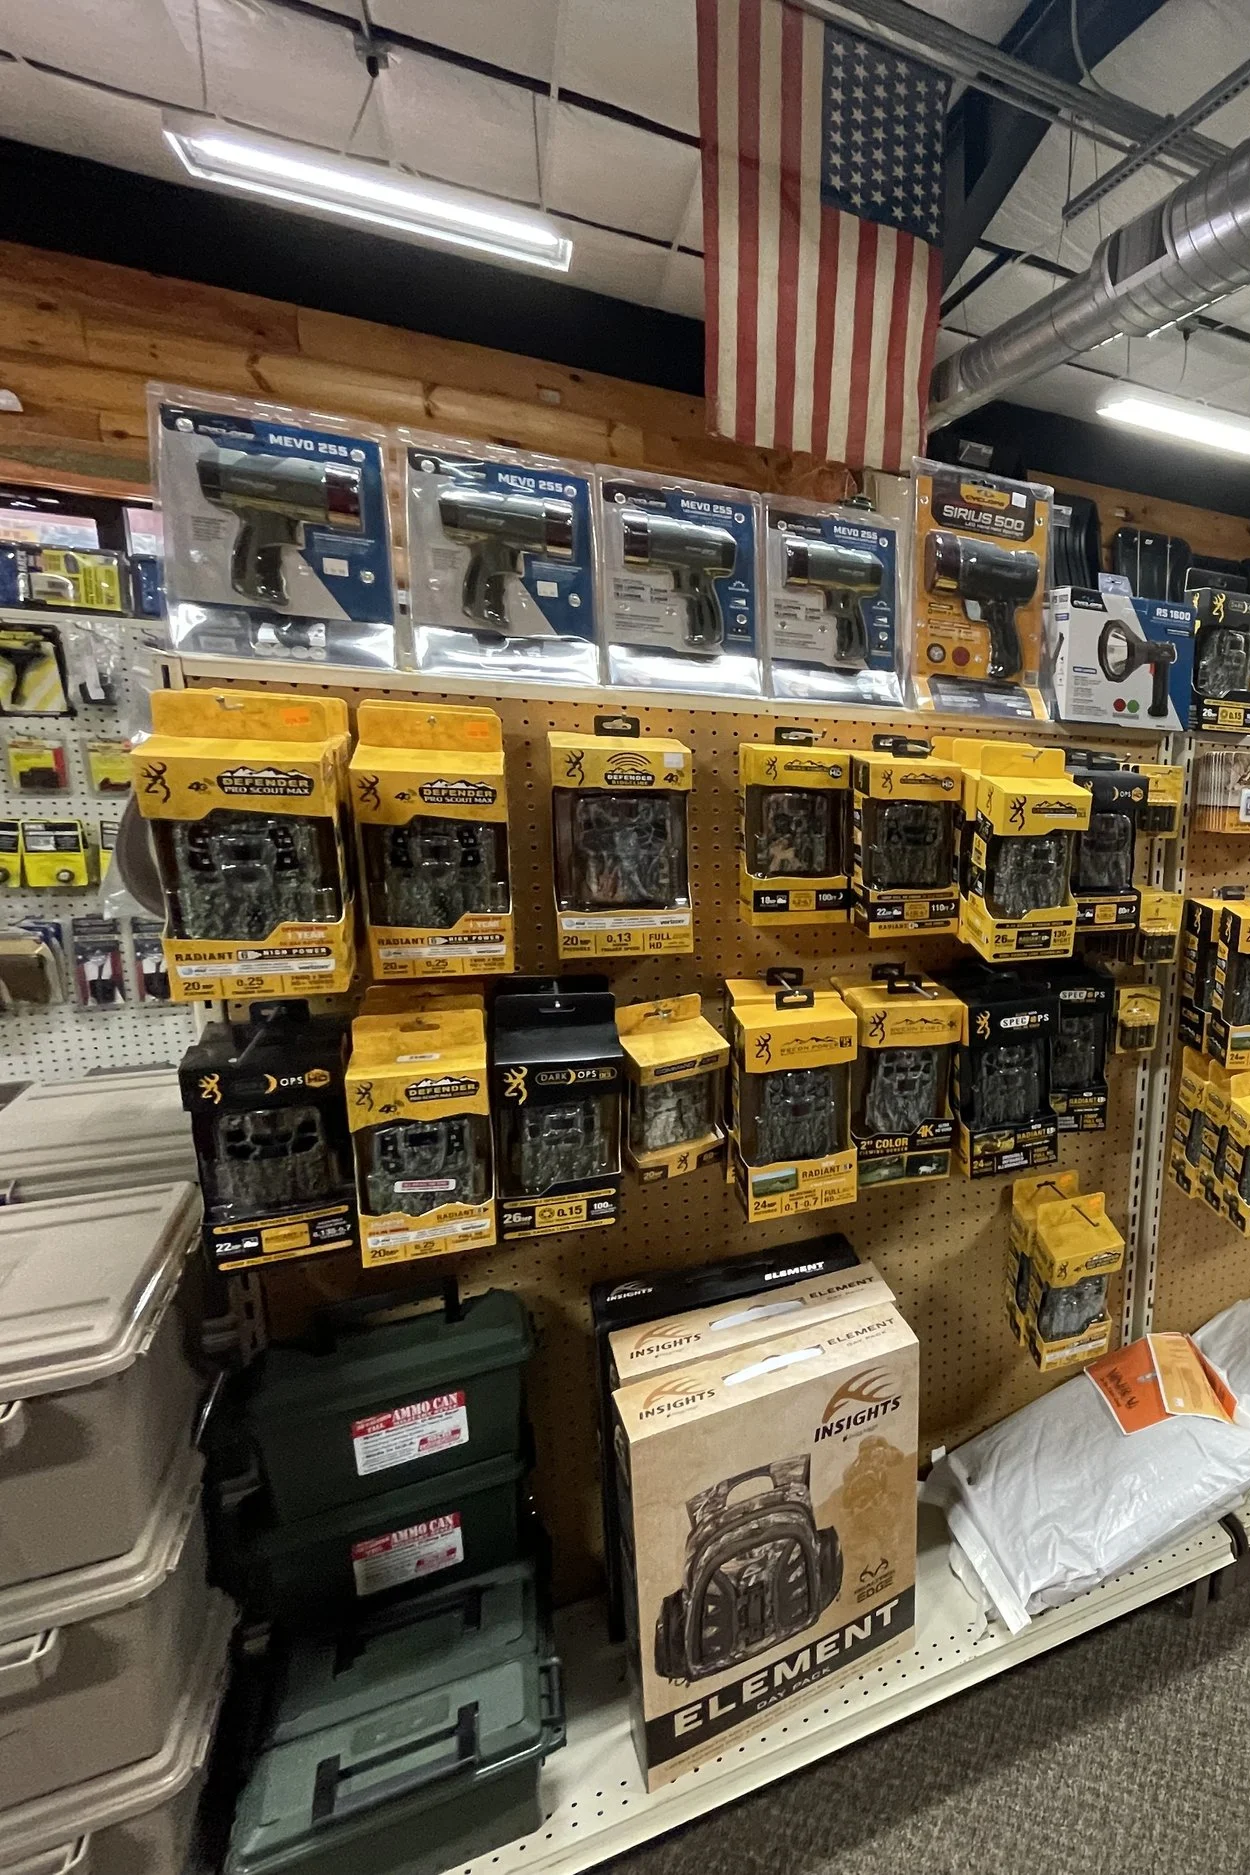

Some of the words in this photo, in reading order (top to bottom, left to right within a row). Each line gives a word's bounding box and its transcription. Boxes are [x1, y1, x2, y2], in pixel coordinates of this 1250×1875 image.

[269, 433, 314, 451] MEVO
[318, 442, 348, 457] 255
[498, 472, 534, 488] MEVO
[539, 480, 564, 494] 255
[681, 499, 710, 513] MEVO
[713, 504, 733, 516] 255
[943, 505, 993, 525] SIRIUS
[994, 515, 1025, 532] 500
[834, 526, 859, 539] MEVO
[861, 530, 878, 541] 255
[1156, 607, 1168, 618] RS
[1169, 609, 1191, 621] 1600
[222, 777, 310, 788] DEFENDER
[606, 773, 654, 782] DEFENDER
[224, 786, 248, 794] PRO
[249, 786, 286, 795] SCOUT
[286, 786, 310, 795] MAX
[423, 788, 495, 798] DEFENDER
[1120, 790, 1132, 798] OPS
[424, 796, 444, 804] PRO
[444, 796, 473, 804] SCOUT
[474, 797, 494, 805] MAX
[377, 937, 426, 947] RADIANT
[472, 934, 500, 942] POWER
[607, 932, 632, 943] 0.13
[649, 933, 672, 941] FULL
[175, 951, 234, 963] RADIANT
[292, 947, 327, 955] POWER
[426, 959, 448, 968] 0.25
[236, 976, 264, 987] 0.25
[1061, 990, 1085, 999] SPEC
[1002, 1016, 1028, 1027] SPEC
[655, 1061, 695, 1075] COMMAND
[280, 1076, 303, 1087] OPS
[540, 1072, 567, 1082] DARK
[577, 1069, 597, 1080] OPS
[409, 1083, 477, 1096] DEFENDER
[917, 1124, 935, 1138] 4K
[875, 1137, 908, 1149] COLOR
[801, 1164, 841, 1179] RADIANT
[824, 1188, 841, 1196] FULL
[436, 1209, 475, 1220] RADIANT
[557, 1205, 582, 1218] 0.15
[764, 1261, 825, 1281] ELEMENT
[606, 1286, 653, 1302] INSIGHTS
[809, 1276, 875, 1299] ELEMENT
[827, 1317, 895, 1346] ELEMENT
[630, 1332, 701, 1360] INSIGHTS
[392, 1400, 431, 1423] AMMO
[433, 1391, 458, 1409] CAN
[639, 1388, 716, 1421] INSIGHTS
[814, 1395, 902, 1444] INSIGHTS
[391, 1522, 428, 1545] AMMO
[429, 1513, 454, 1535] CAN
[857, 1576, 894, 1604] EDGE
[674, 1598, 900, 1738] ELEMENT
[757, 1690, 787, 1711] DAY
[792, 1665, 831, 1692] PACK
